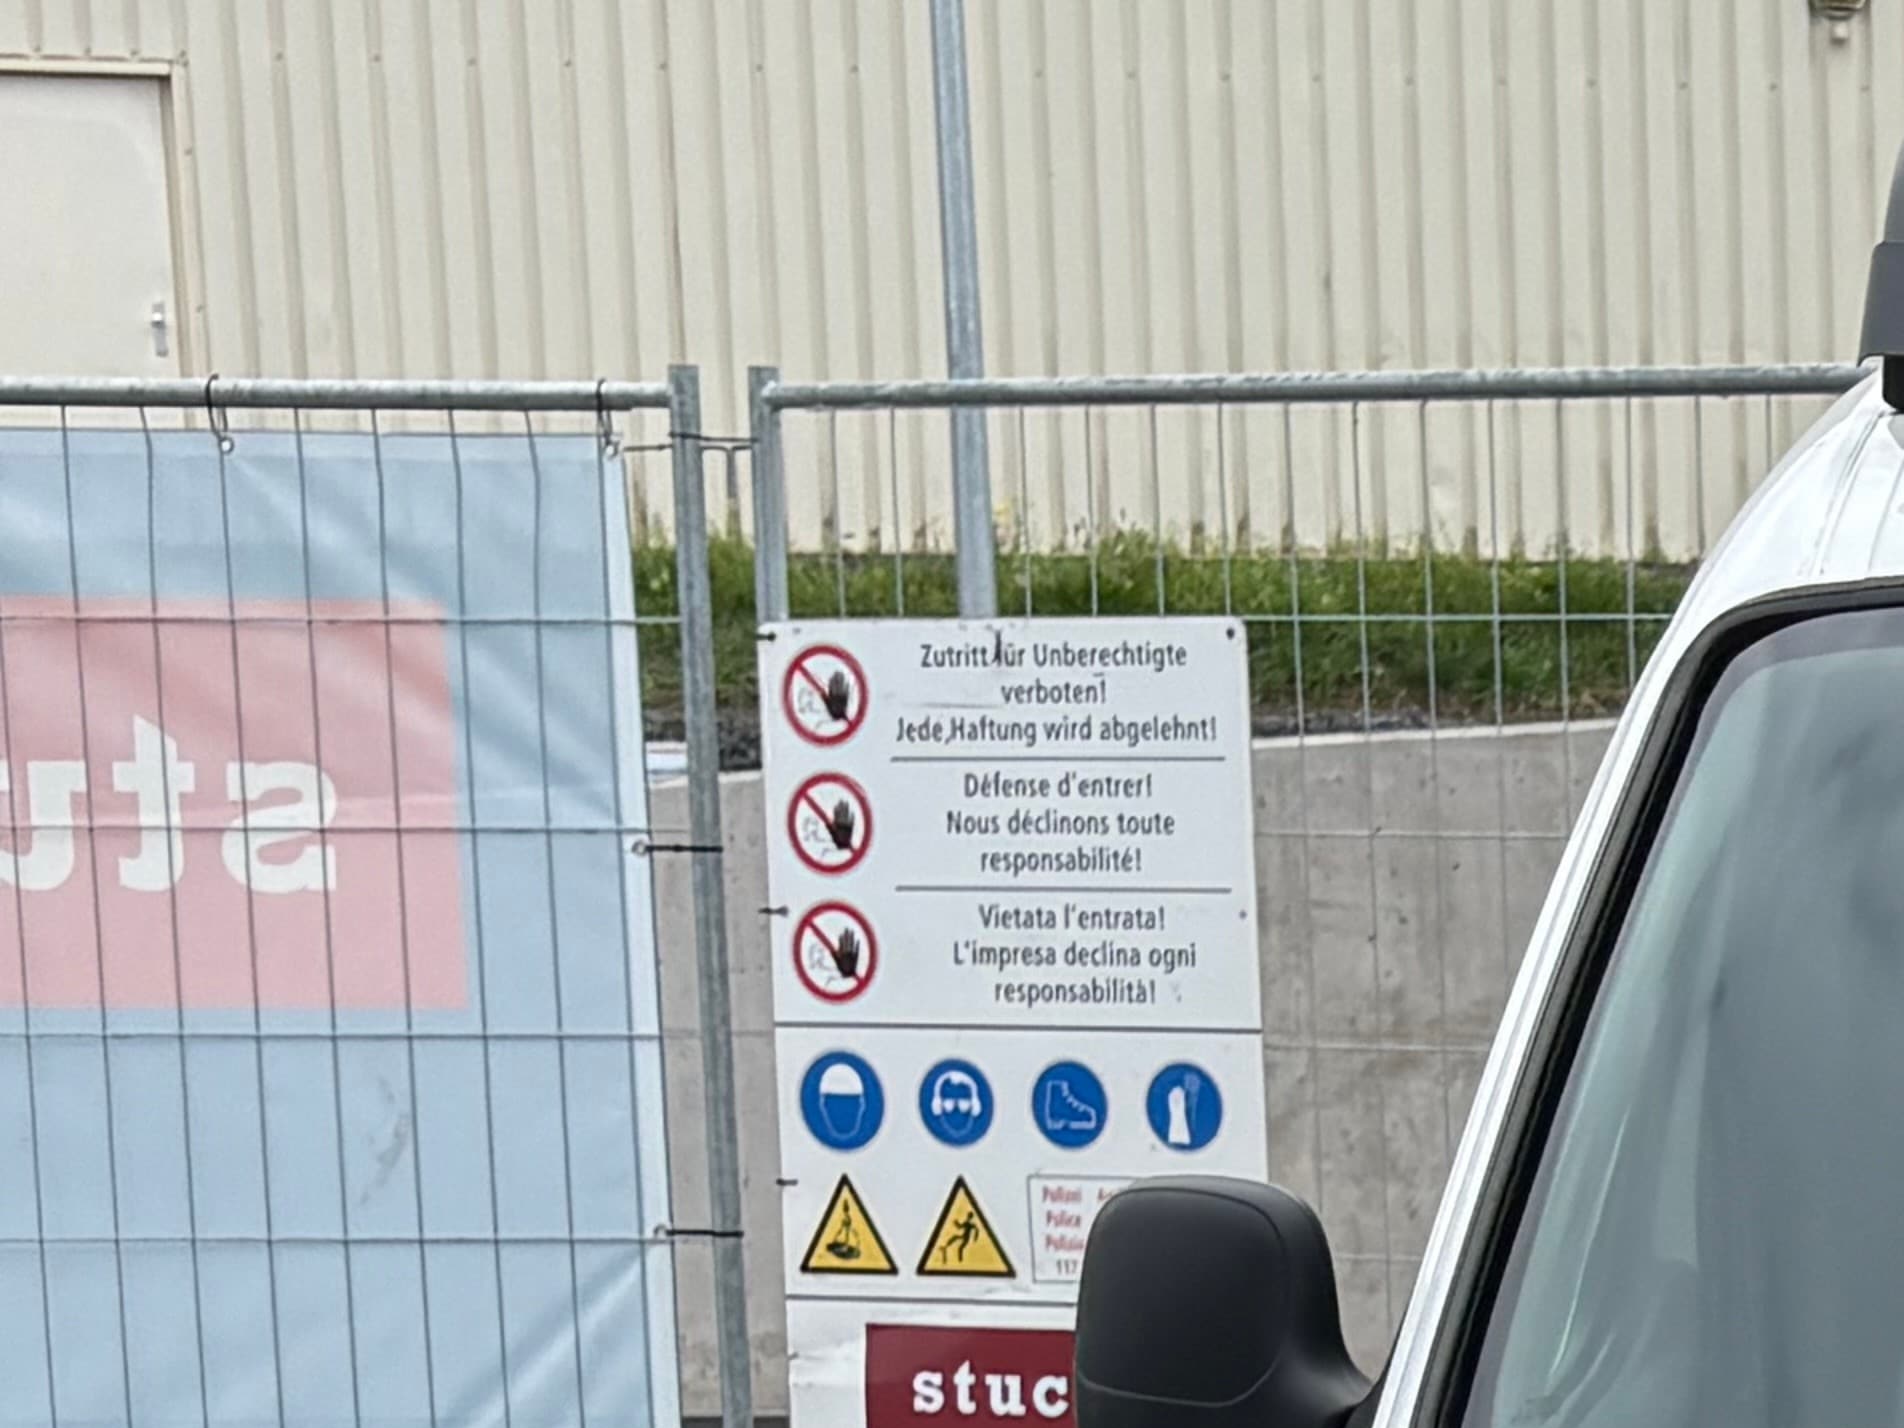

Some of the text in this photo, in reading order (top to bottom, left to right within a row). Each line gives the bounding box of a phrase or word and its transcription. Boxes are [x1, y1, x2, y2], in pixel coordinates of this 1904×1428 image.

[920, 643, 989, 668] Zutritt
[1033, 641, 1187, 672] Unberechtigte
[1001, 678, 1106, 704] verboten!
[896, 714, 1217, 747] Jede Haftung wird abgelehnt!
[964, 771, 1152, 798] Défense d'entrer!
[947, 809, 1175, 836] Nous déclinons toute
[980, 846, 1142, 878] responsabilité!
[978, 902, 1166, 931] Vietata l'entrata!
[953, 940, 1196, 974] L'impresa declina ogni
[995, 977, 1156, 1008] responsabilità!
[913, 1360, 1069, 1418] stuc
